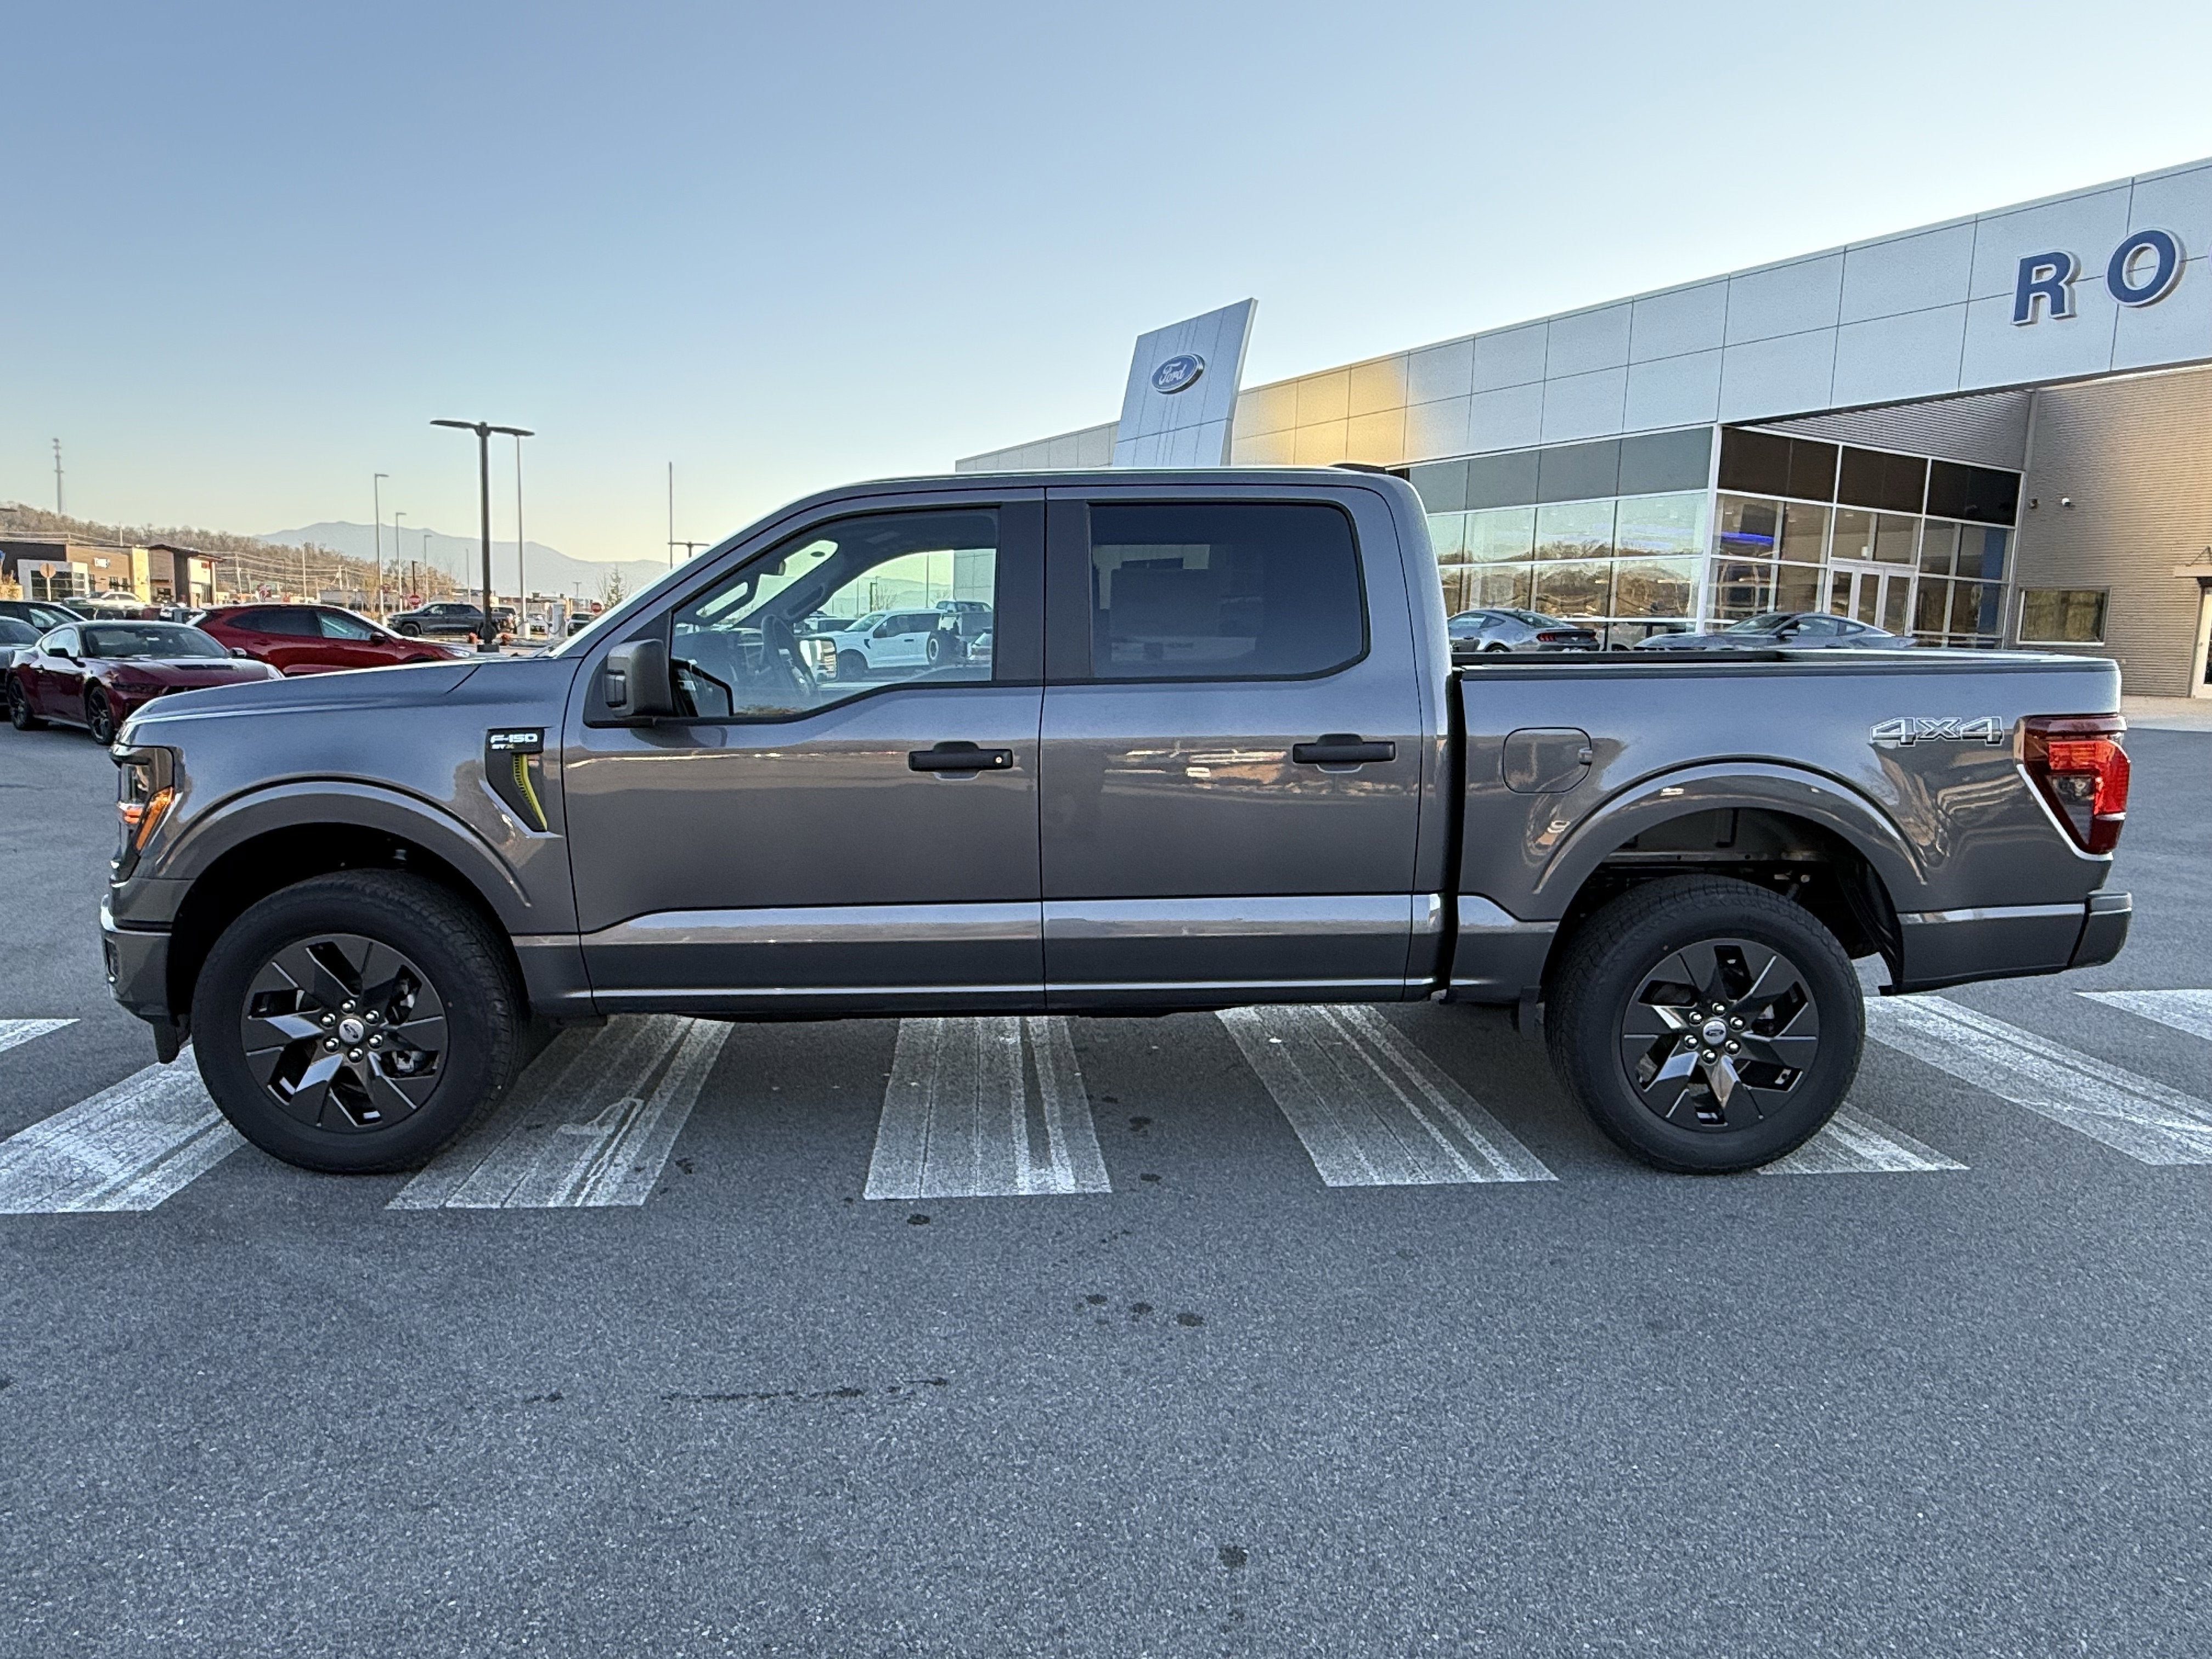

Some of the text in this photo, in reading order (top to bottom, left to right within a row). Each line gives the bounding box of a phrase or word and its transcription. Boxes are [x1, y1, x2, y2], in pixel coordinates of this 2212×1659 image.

[2011, 227, 2212, 326] RO
[1159, 361, 1187, 385] Ford
[490, 733, 538, 744] F-150
